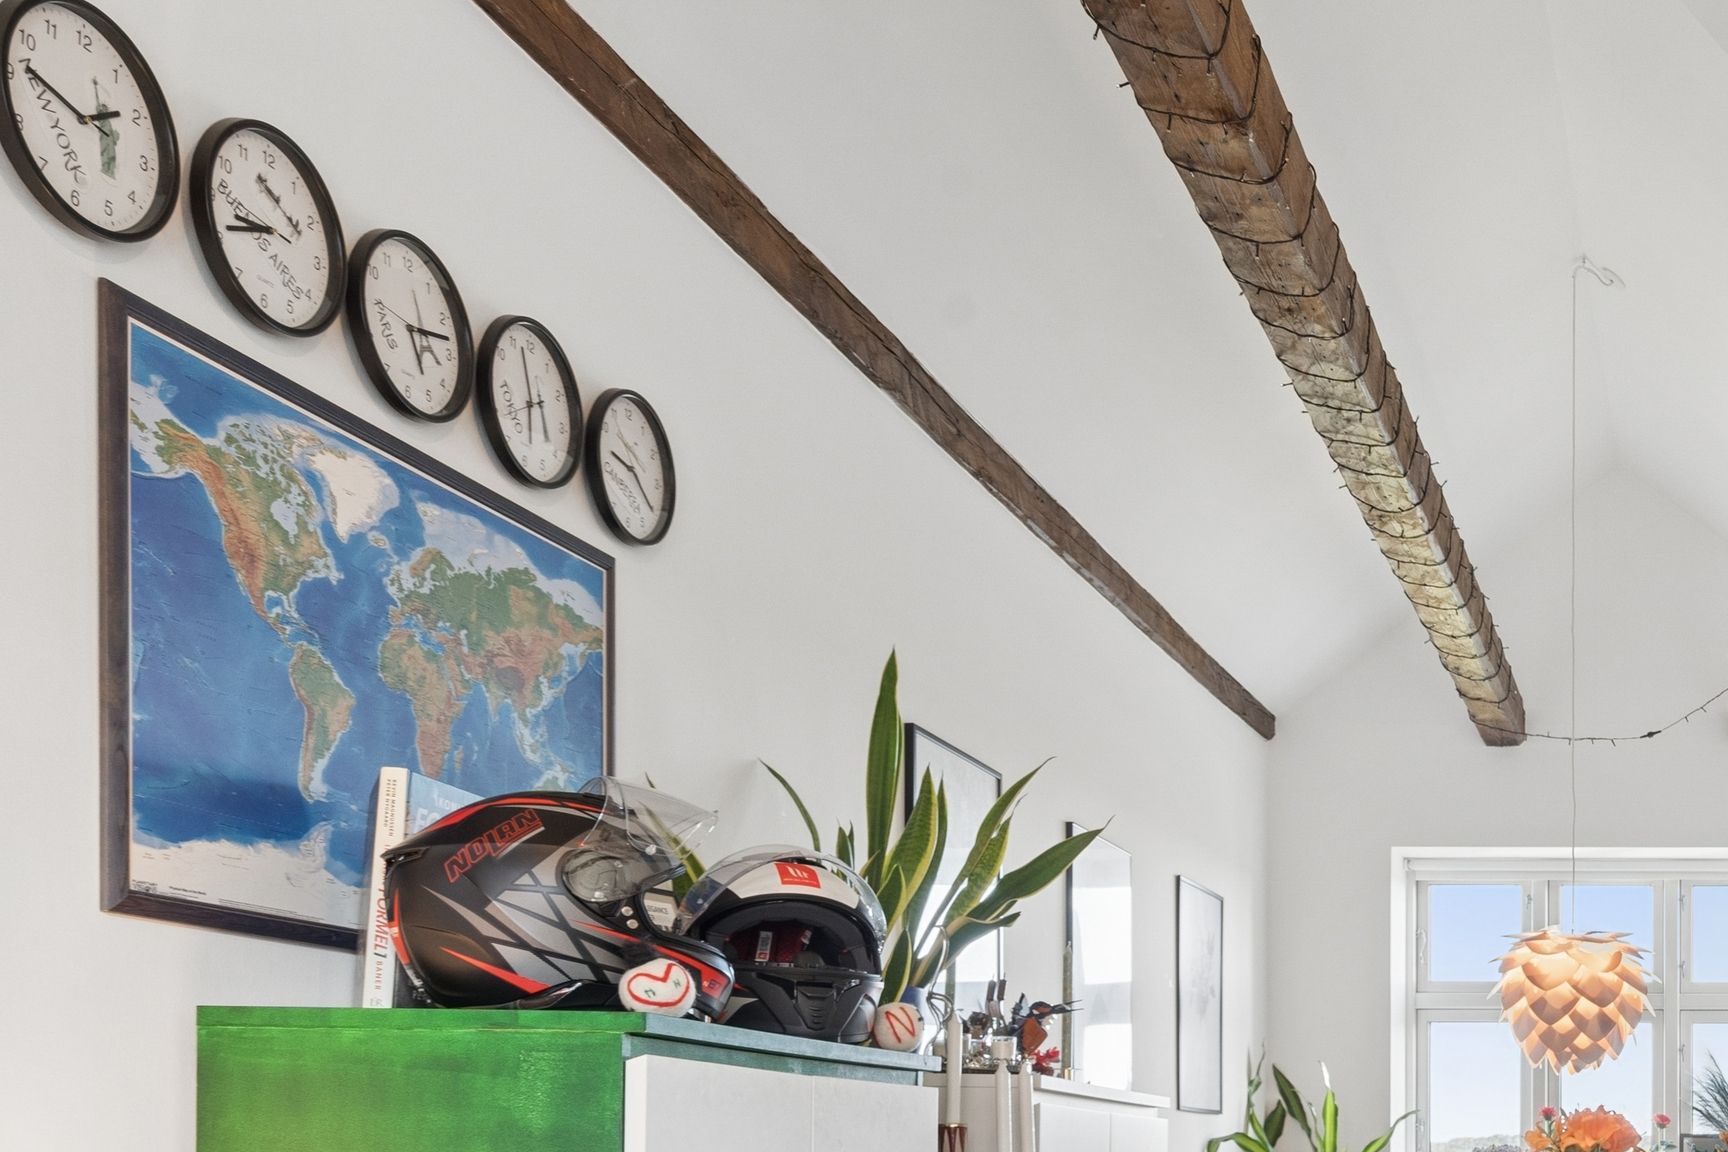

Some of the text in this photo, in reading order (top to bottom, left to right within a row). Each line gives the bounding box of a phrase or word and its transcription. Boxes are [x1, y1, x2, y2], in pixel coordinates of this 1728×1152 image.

[44, 19, 57, 40] 11
[18, 29, 36, 51] 10
[75, 30, 92, 53] 12
[112, 69, 119, 84] 1
[132, 109, 141, 126] 2
[49, 117, 87, 184] YORK
[237, 143, 248, 161] 11
[139, 155, 148, 172] 3
[218, 155, 233, 174] 10
[261, 150, 276, 170] 12
[291, 181, 297, 195] 1
[71, 190, 80, 207] 6
[127, 190, 136, 205] 4
[104, 200, 113, 217] 5
[306, 215, 315, 231] 2
[313, 256, 321, 271] 3
[382, 252, 391, 268] 11
[402, 256, 413, 273] 12
[268, 253, 304, 301] AIRES
[260, 294, 269, 309] 6
[304, 288, 312, 300] 4
[286, 300, 295, 315] 5
[373, 298, 400, 350] PARIS
[439, 311, 446, 326] 2
[445, 348, 453, 362] 3
[404, 385, 412, 399] 6
[425, 389, 432, 403] 5
[499, 379, 523, 435] TOKYO
[444, 808, 543, 883] NOLAN
